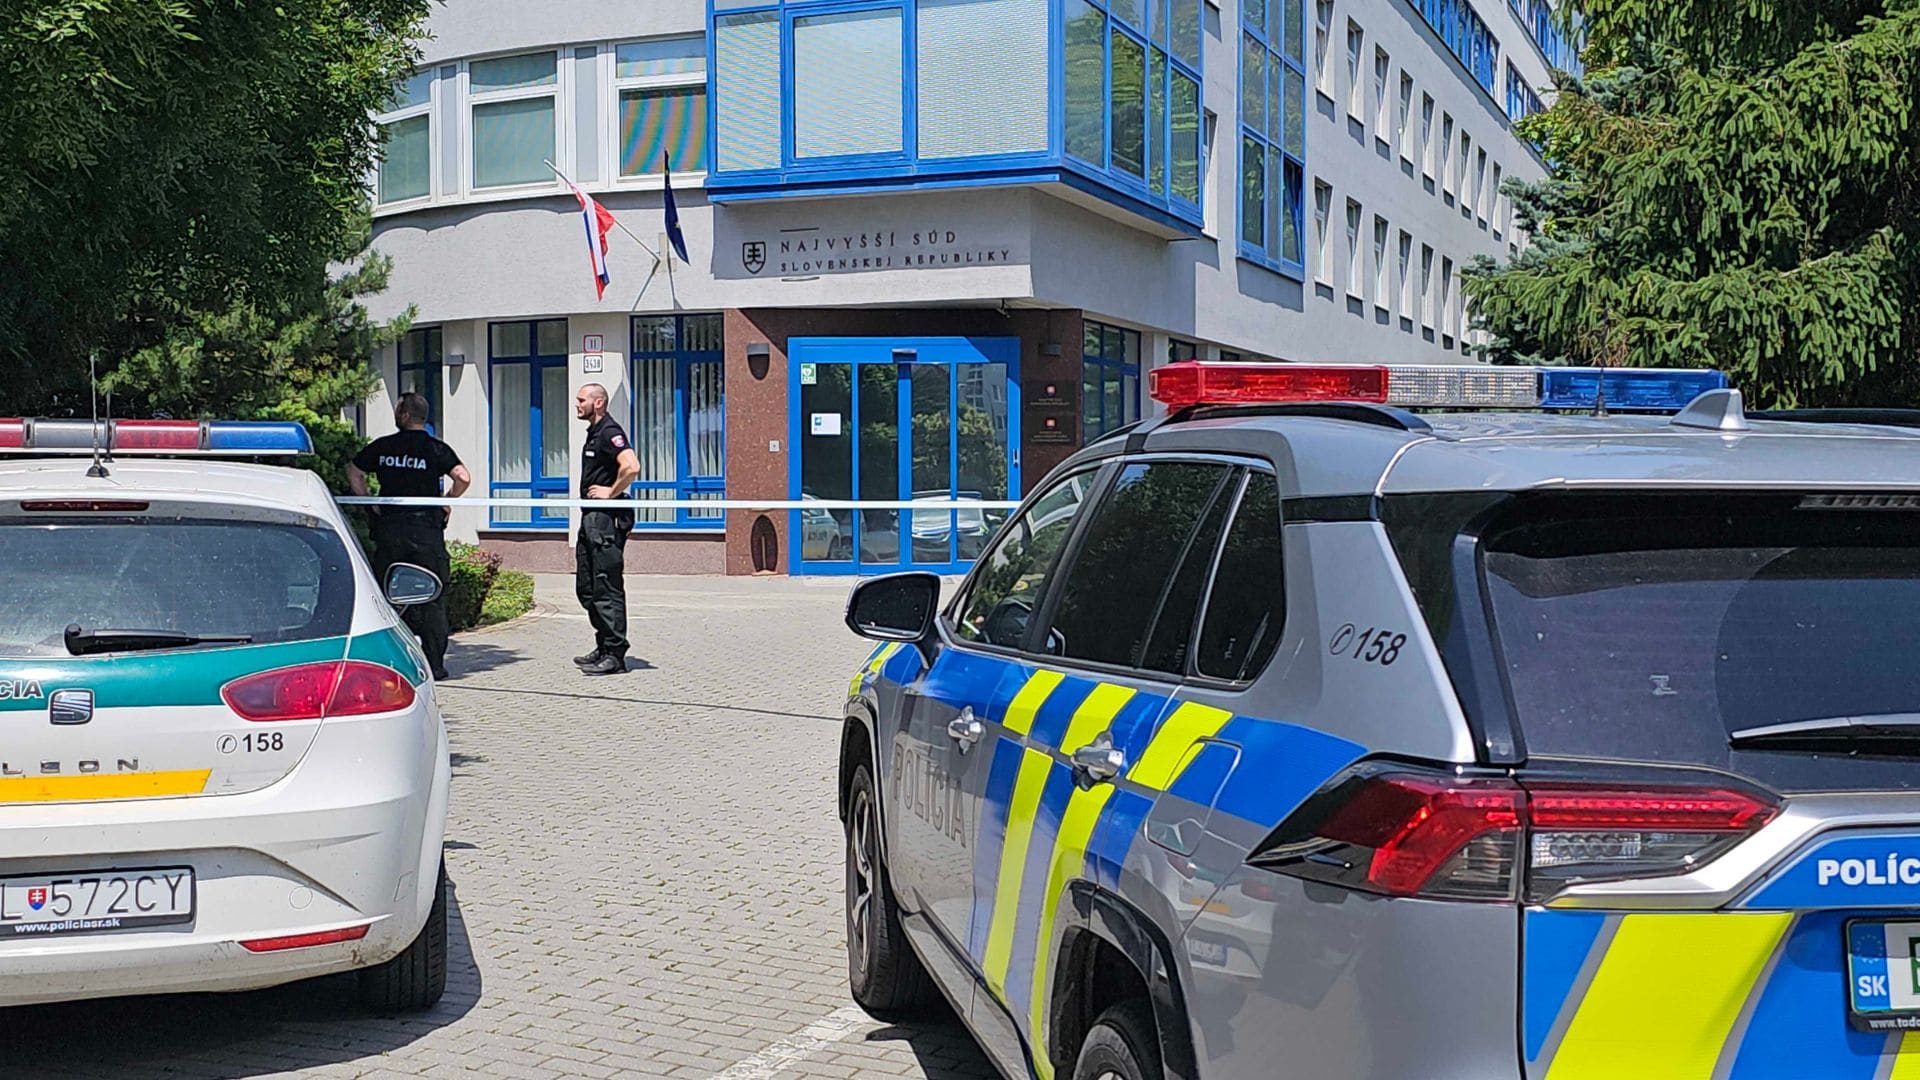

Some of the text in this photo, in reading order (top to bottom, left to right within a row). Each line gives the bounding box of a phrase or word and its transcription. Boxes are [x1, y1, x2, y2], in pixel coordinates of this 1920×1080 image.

[780, 229, 956, 253] NAJVYŠŠÍ SÚD
[780, 250, 1010, 272] SLOVENSKEJ REPUBLIKY
[379, 454, 427, 470] POLÍCIA
[1352, 626, 1408, 666] 158
[0, 679, 45, 700] CIA
[242, 731, 285, 752] 158
[2, 757, 139, 775] LEON
[1817, 852, 1920, 886] POLÍC
[50, 873, 185, 918] 572CY
[15, 917, 121, 933] www.policiasr.sk
[1858, 974, 1888, 997] SK
